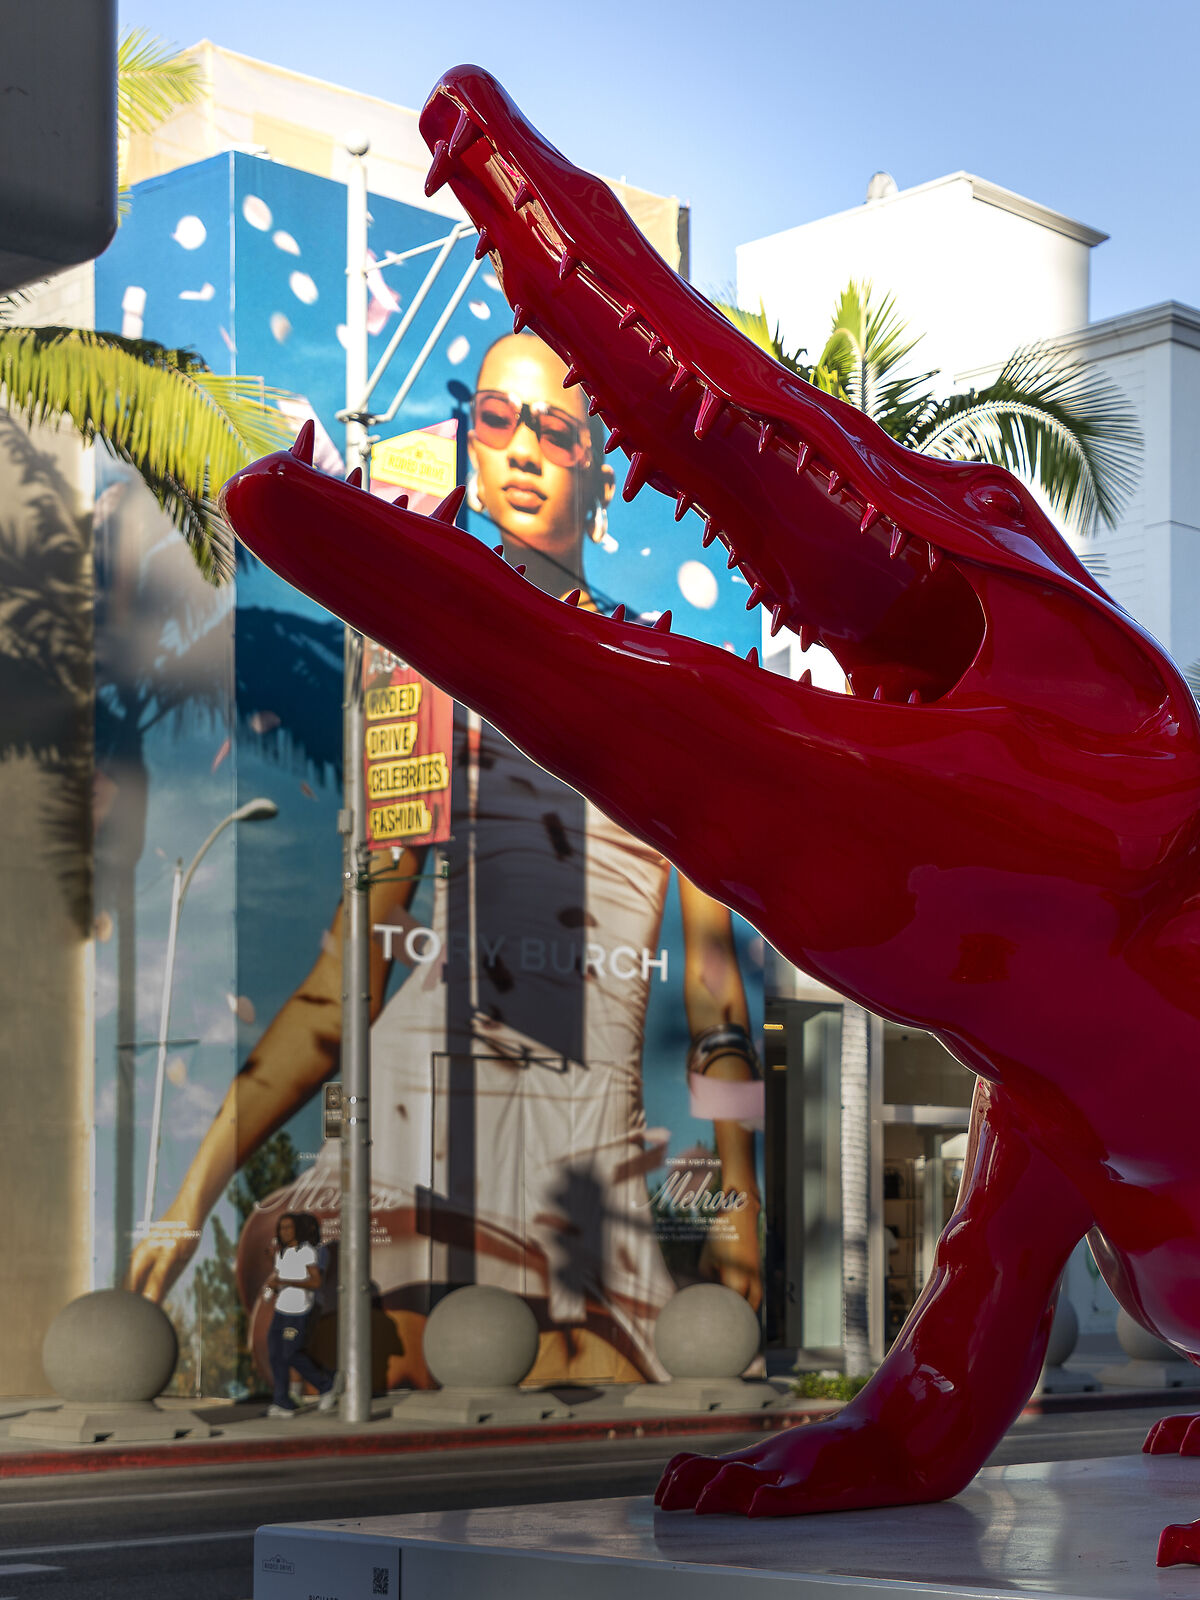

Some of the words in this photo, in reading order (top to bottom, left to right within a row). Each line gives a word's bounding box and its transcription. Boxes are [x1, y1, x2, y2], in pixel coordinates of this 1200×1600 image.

[371, 688, 415, 714] RODEO
[371, 728, 409, 754] DRIVE
[372, 760, 442, 793] CELEBRATES
[372, 806, 422, 833] FASHION
[373, 923, 505, 967] TORY
[520, 936, 669, 983] BURCH
[630, 1170, 748, 1212] Melrose
